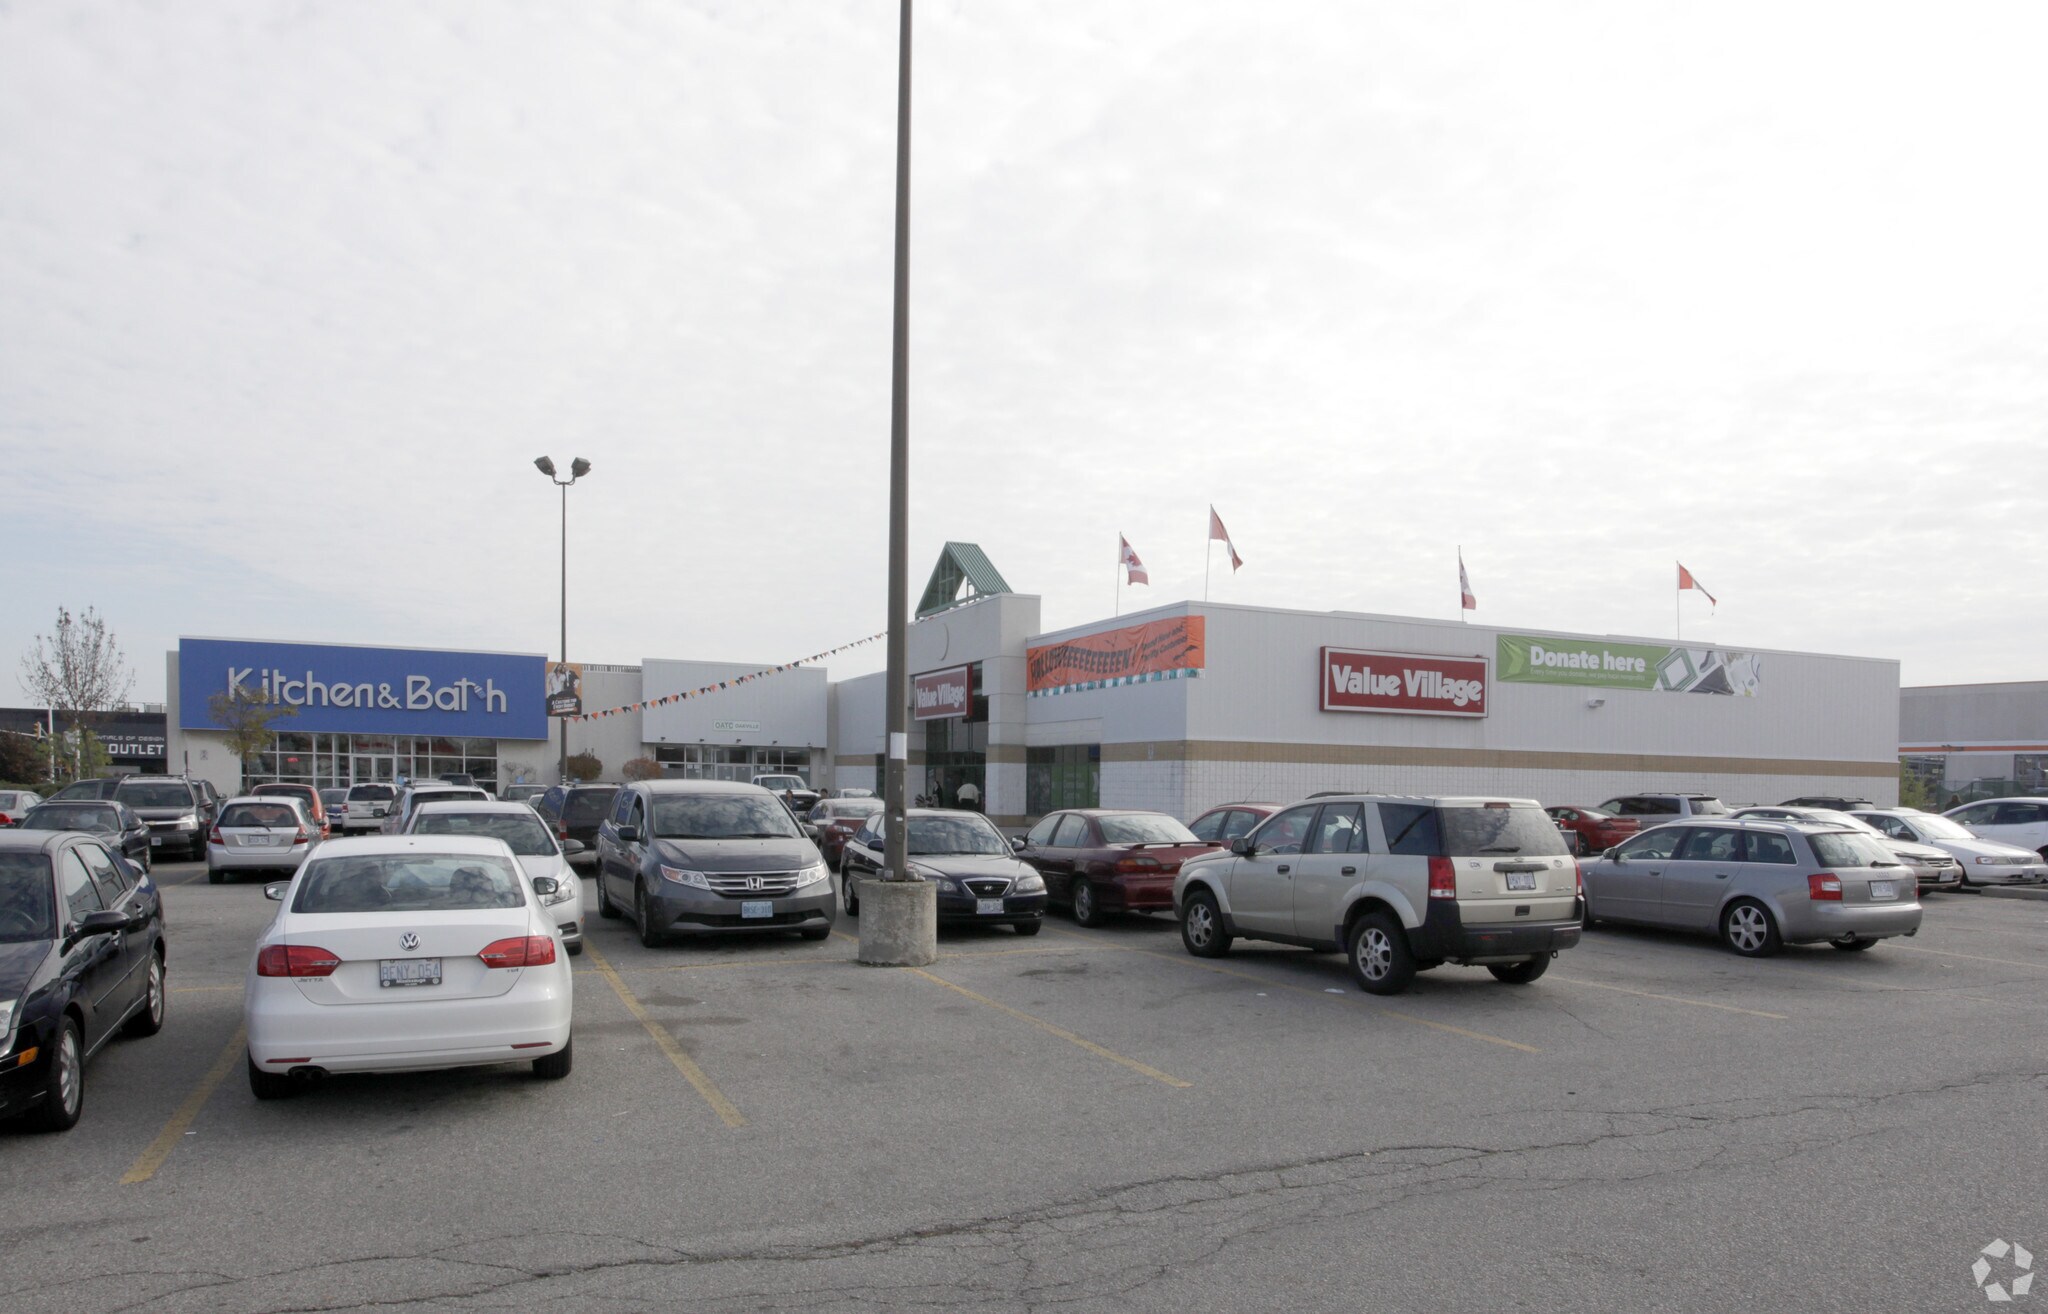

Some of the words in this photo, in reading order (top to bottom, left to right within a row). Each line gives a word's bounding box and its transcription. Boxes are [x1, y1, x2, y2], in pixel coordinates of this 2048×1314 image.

[1530, 646, 1600, 669] Donate
[1603, 651, 1646, 673] here
[228, 667, 374, 708] Kitchen
[406, 675, 507, 713] Bath
[916, 686, 937, 709] Value
[937, 683, 965, 709] Village
[1331, 664, 1401, 696] Value
[1403, 669, 1483, 707] Village
[108, 743, 165, 755] OUTLET
